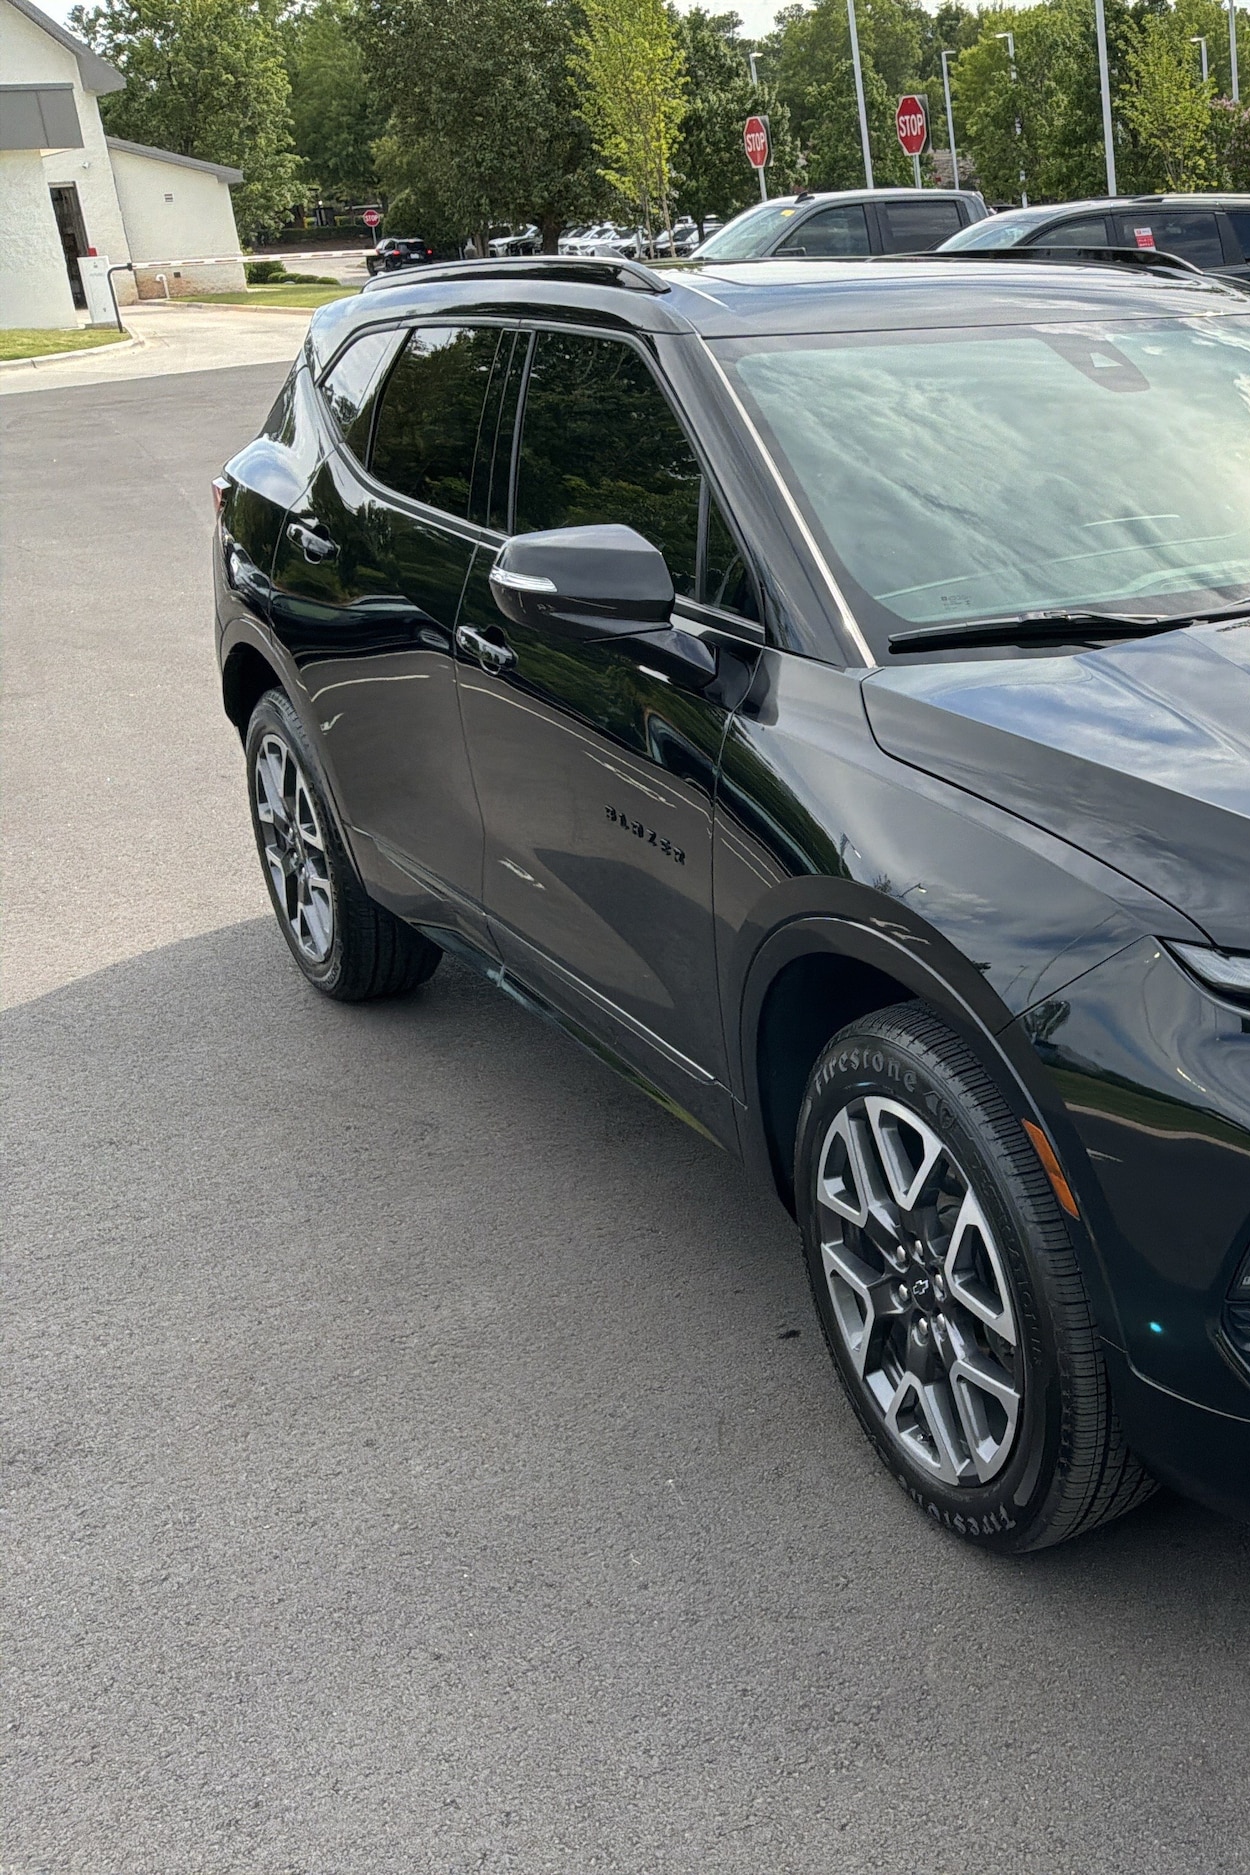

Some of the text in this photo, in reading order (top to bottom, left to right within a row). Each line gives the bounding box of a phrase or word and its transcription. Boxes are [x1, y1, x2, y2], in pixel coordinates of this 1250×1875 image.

[899, 114, 924, 137] STOP
[746, 132, 767, 153] STOP
[364, 214, 379, 222] STOP
